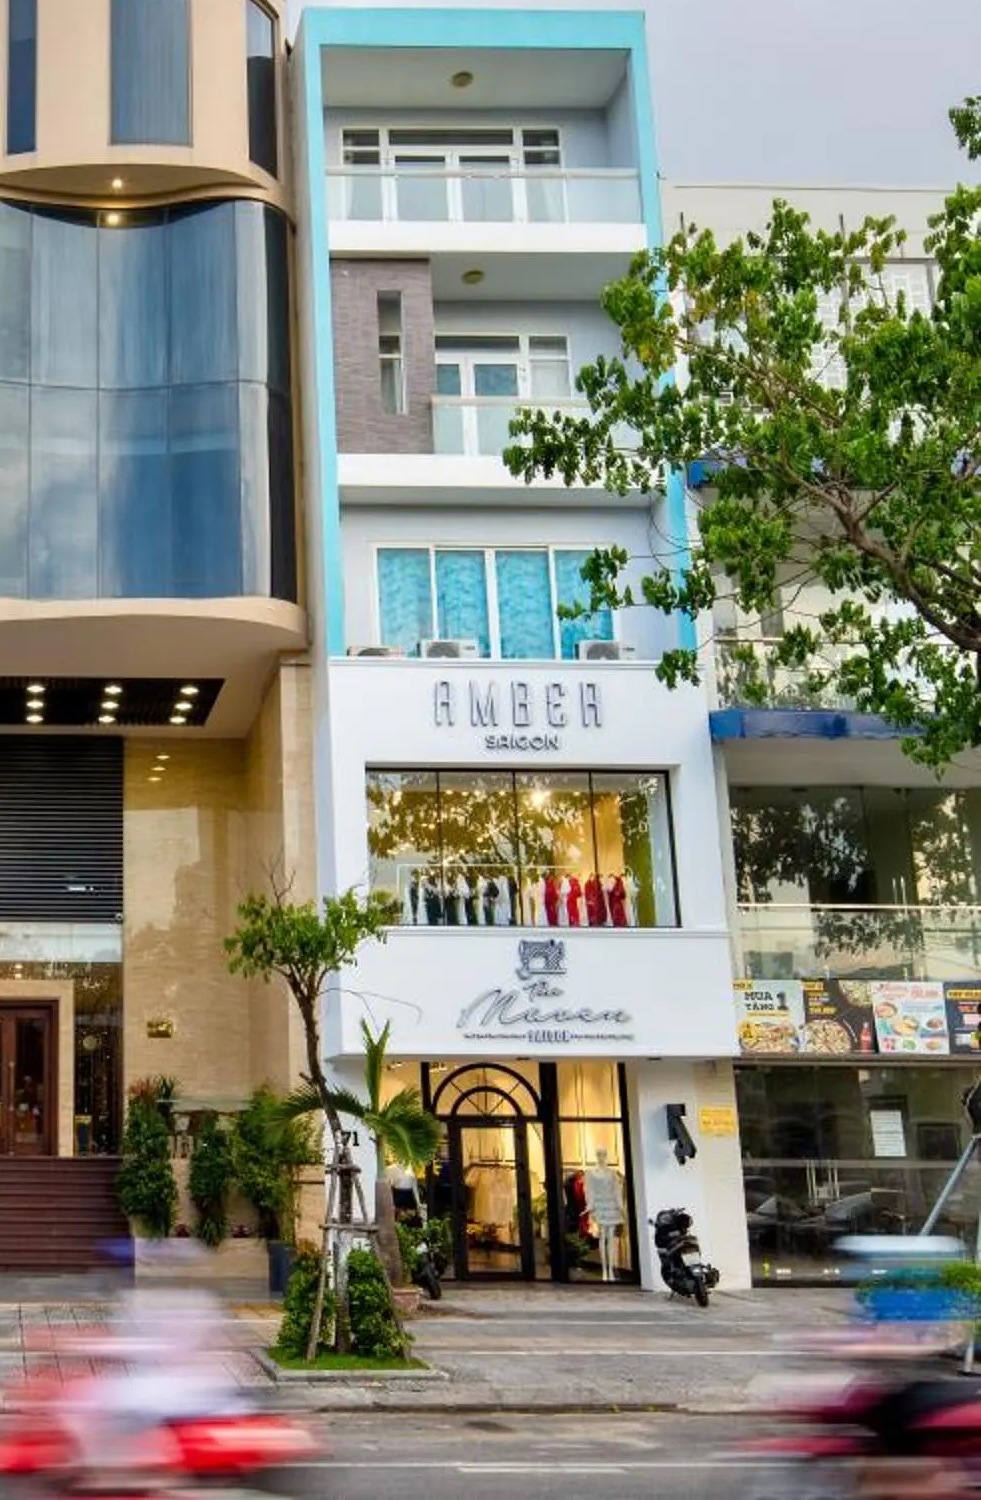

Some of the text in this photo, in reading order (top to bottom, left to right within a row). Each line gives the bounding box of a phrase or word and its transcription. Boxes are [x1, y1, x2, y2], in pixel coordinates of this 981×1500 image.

[434, 680, 602, 728] AMBER
[484, 734, 560, 751] SAIGON
[744, 991, 773, 1001] MUA
